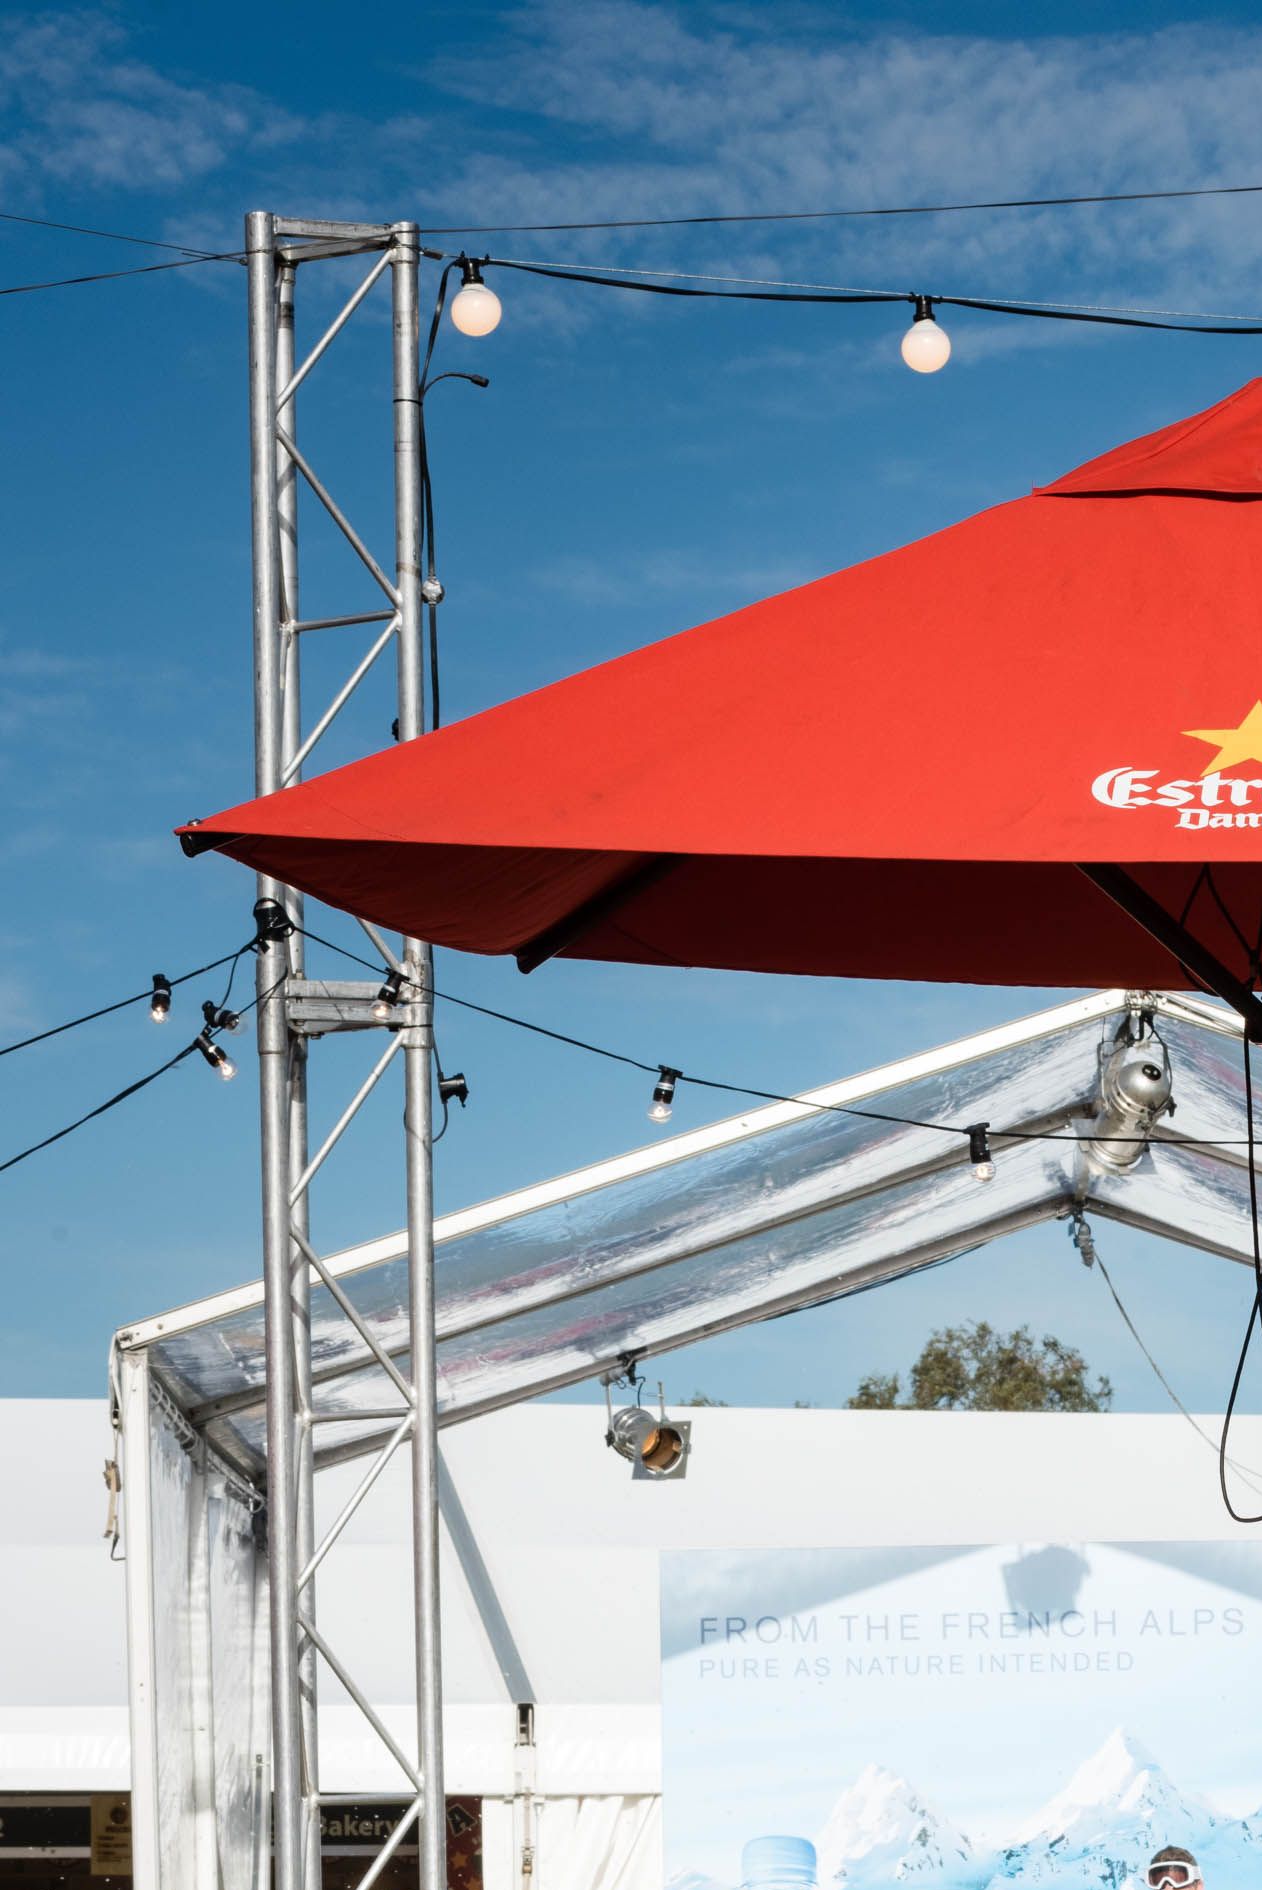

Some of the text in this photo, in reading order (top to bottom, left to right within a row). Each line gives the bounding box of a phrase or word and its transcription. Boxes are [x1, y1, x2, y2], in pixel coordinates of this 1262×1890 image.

[699, 1607, 1246, 1645] FROM THE FRENCH ALPS
[699, 1650, 1135, 1680] PURE AS NATURE INTENDED
